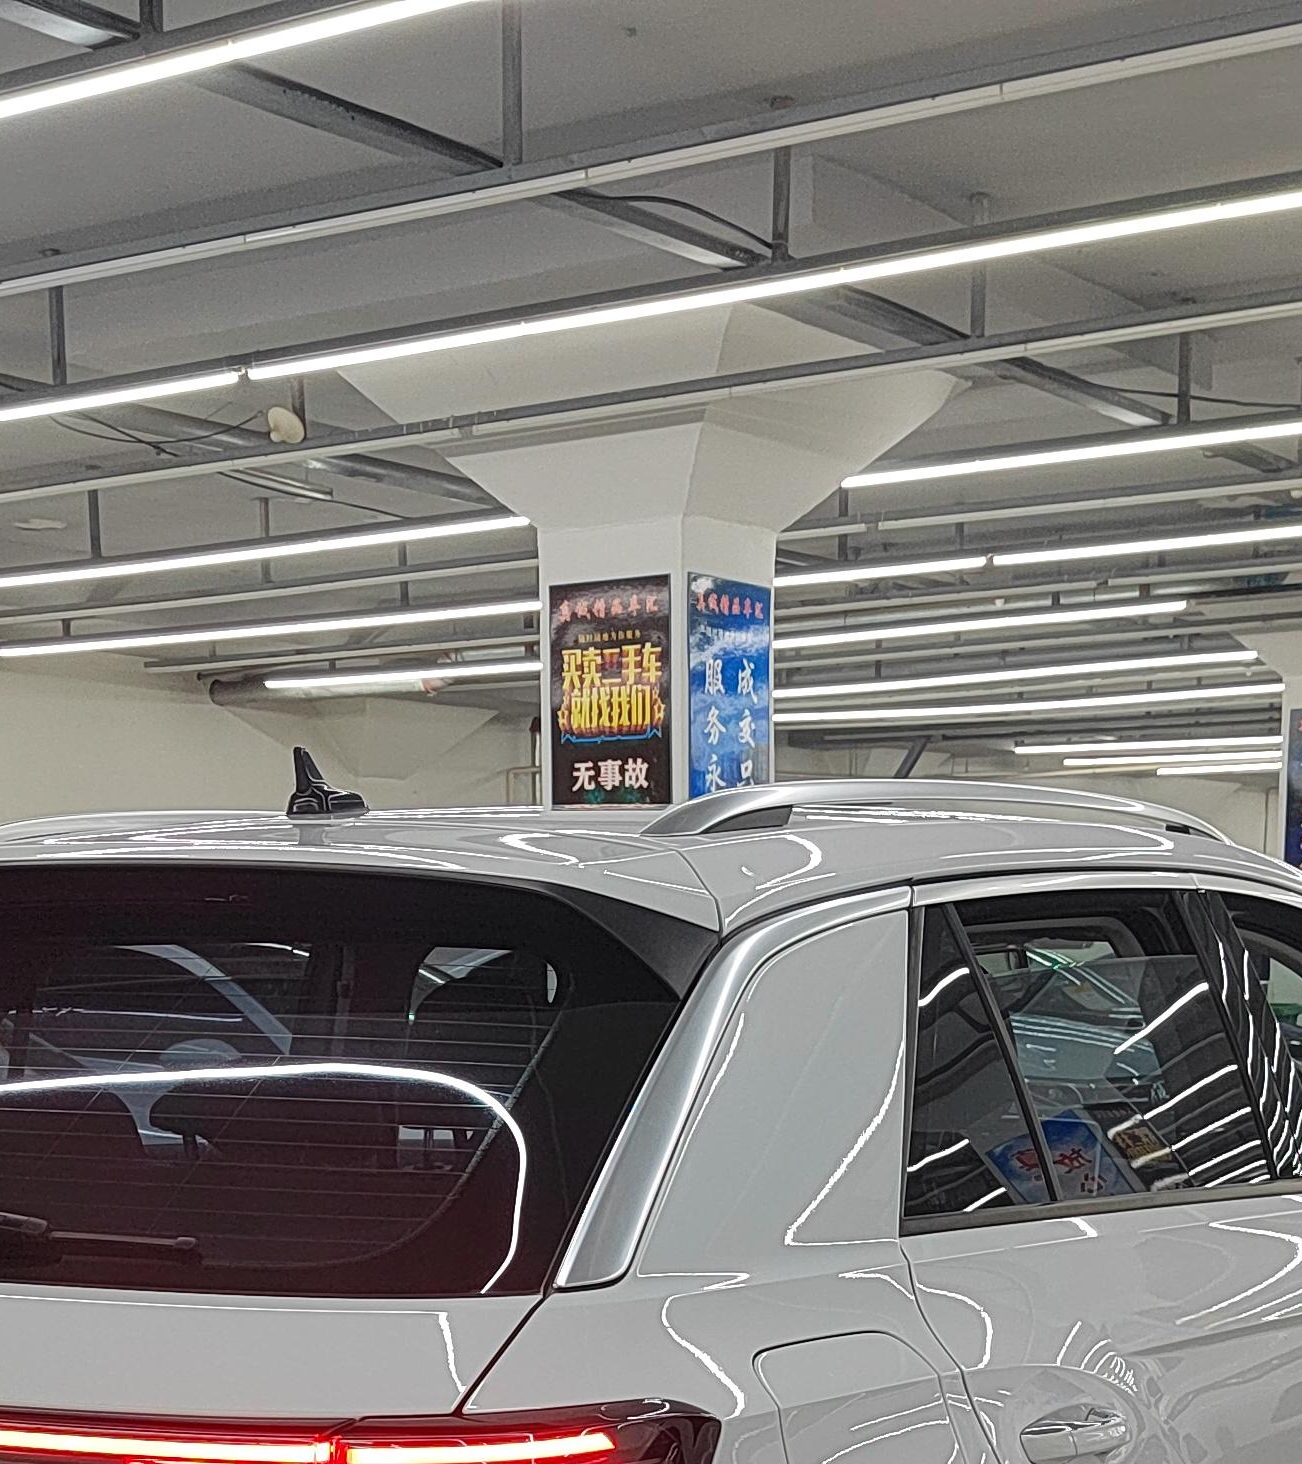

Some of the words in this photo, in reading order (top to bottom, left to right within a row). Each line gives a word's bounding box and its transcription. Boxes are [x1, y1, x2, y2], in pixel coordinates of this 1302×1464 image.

[561, 642, 663, 690] 买卖二手车
[570, 684, 651, 730] 就找我们
[571, 757, 650, 792] 无事故
